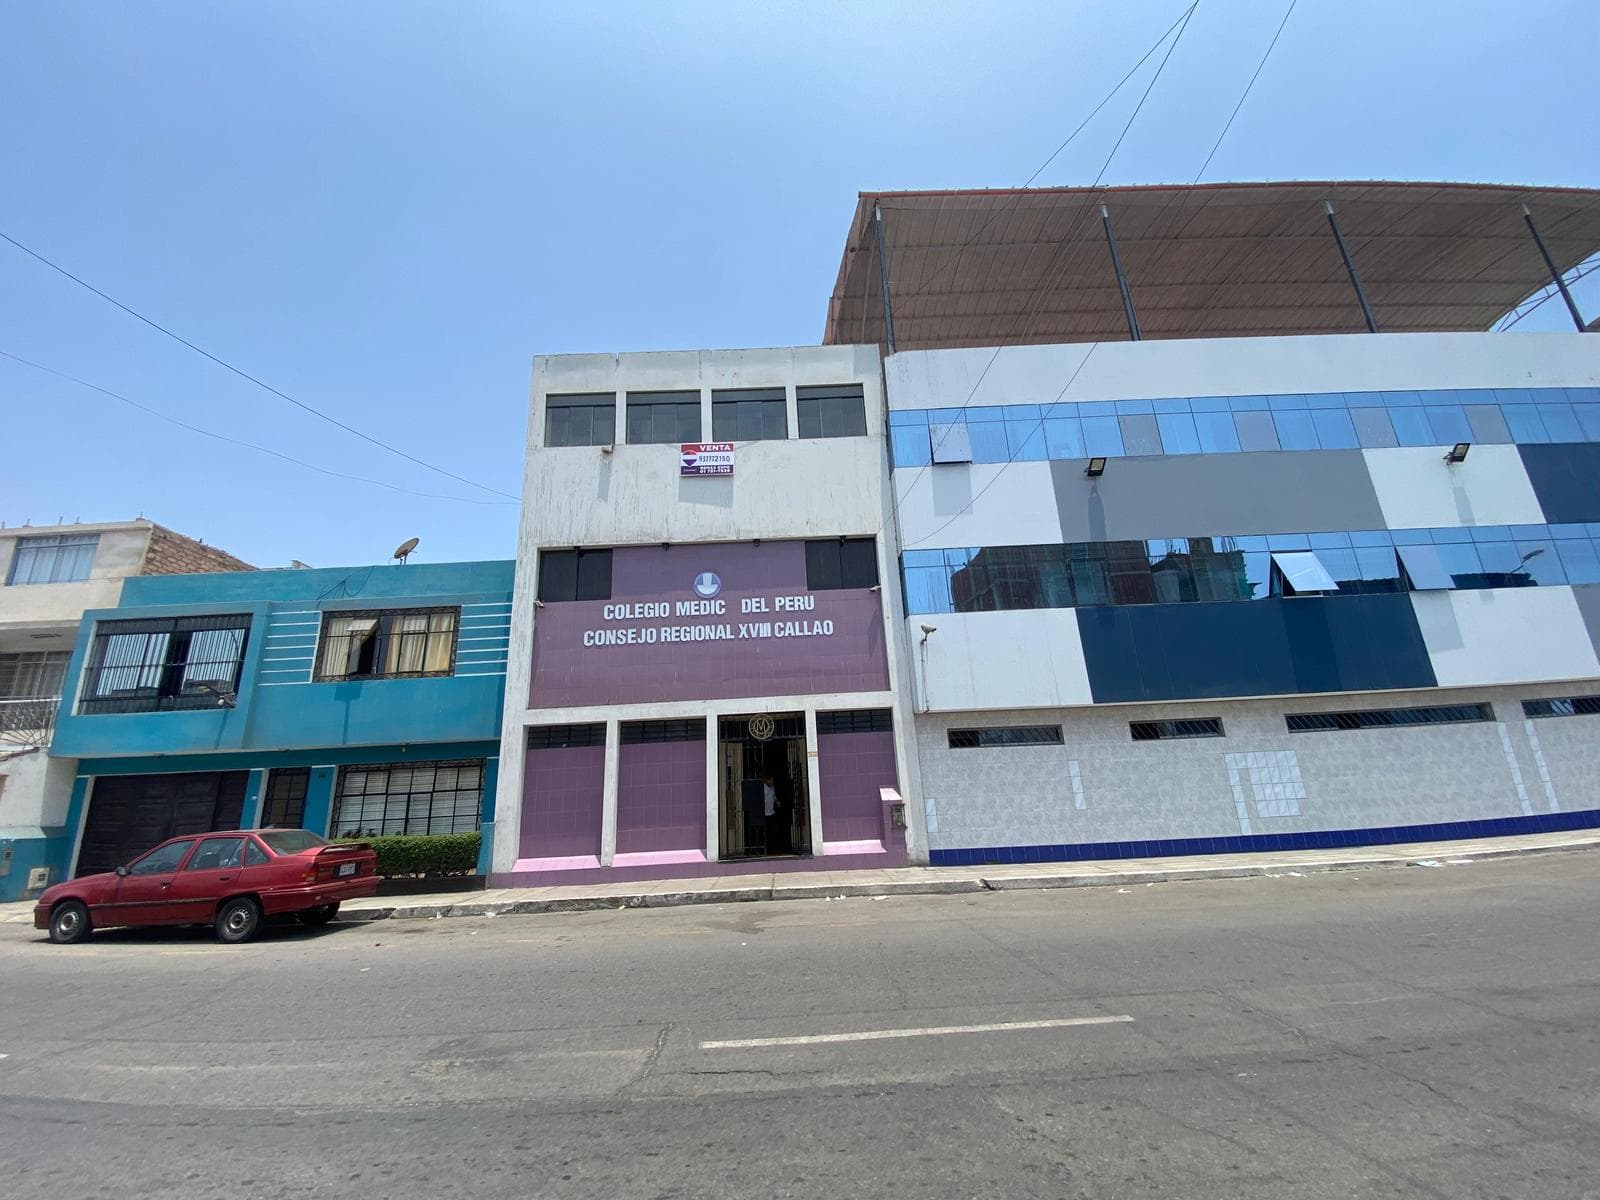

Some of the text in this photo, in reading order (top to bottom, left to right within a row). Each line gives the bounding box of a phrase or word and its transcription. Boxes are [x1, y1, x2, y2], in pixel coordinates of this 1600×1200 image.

[603, 596, 815, 620] COLEGIO MEDIC DEL PERU
[583, 620, 834, 647] CONSEJO REGIONAL XVIII CALLAO
